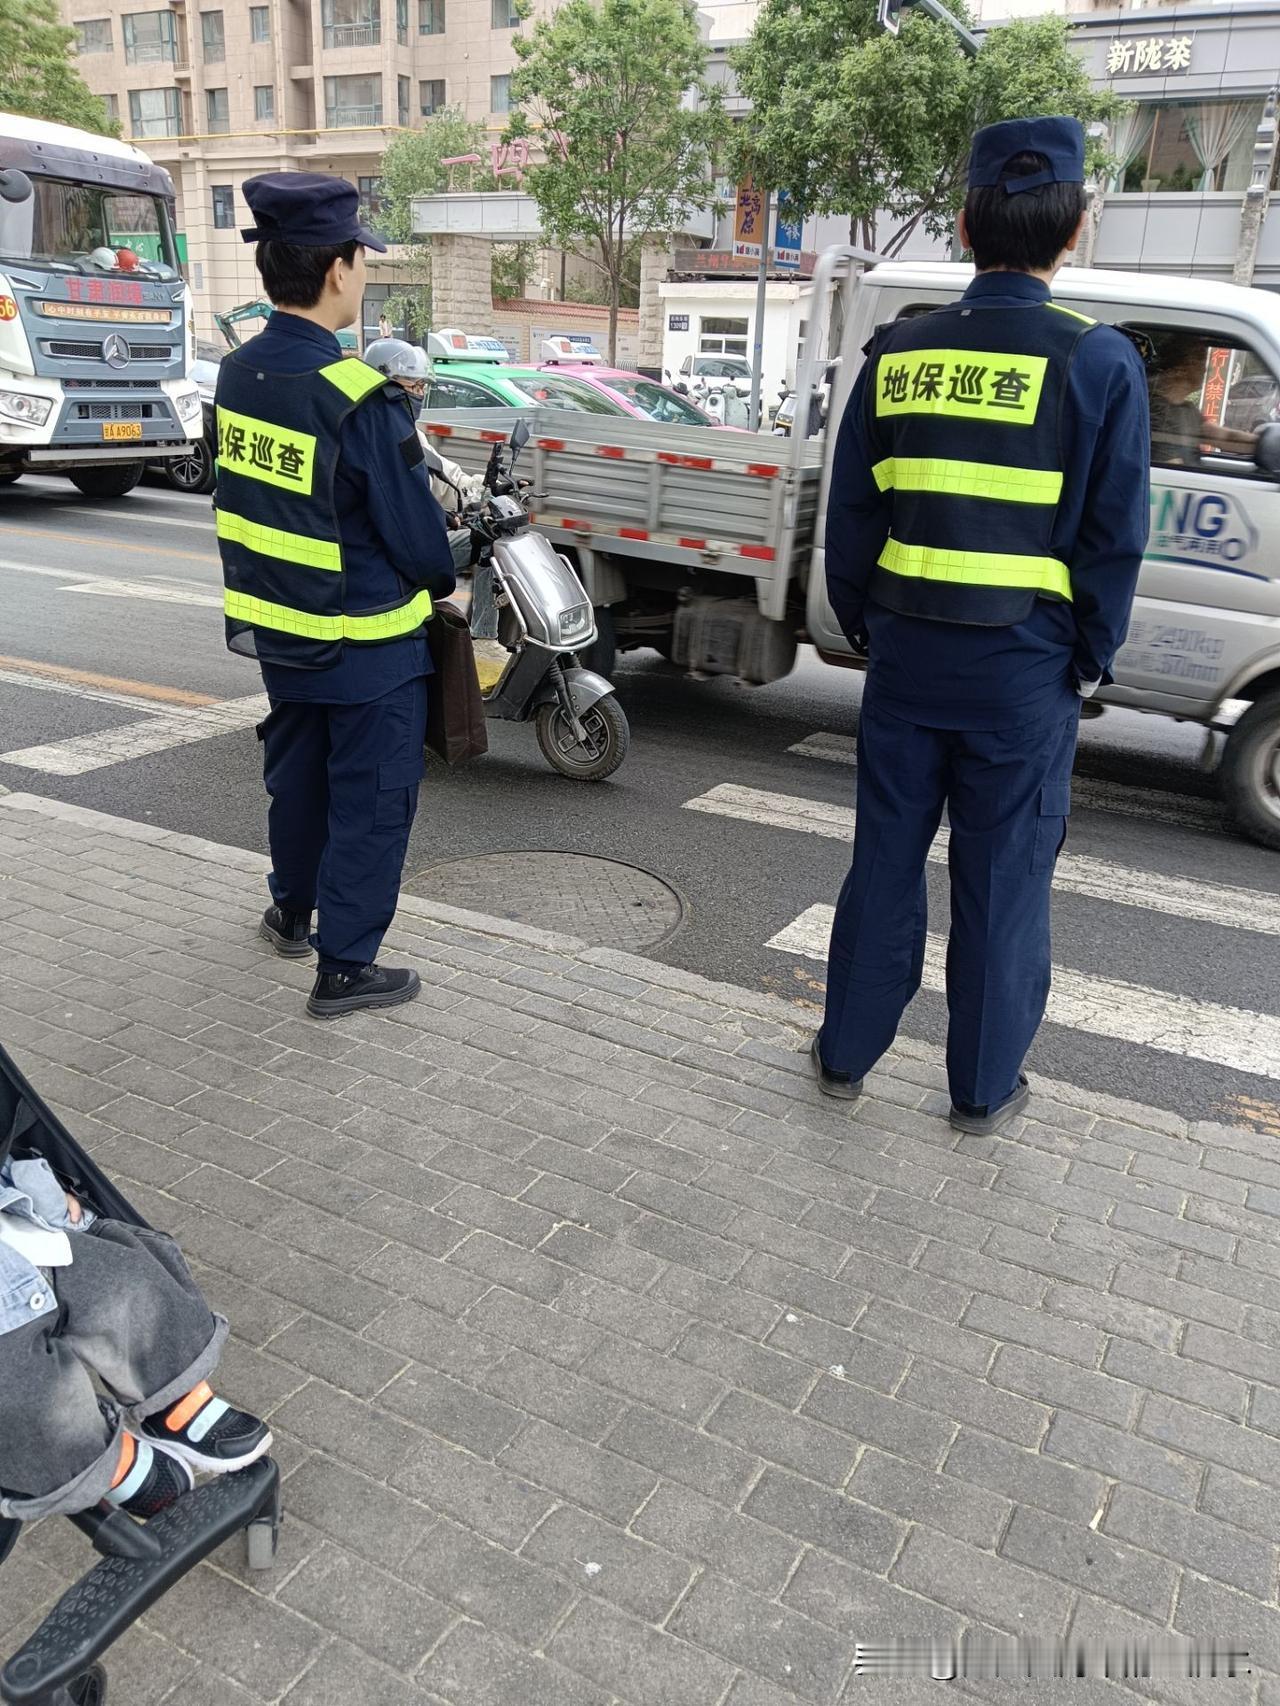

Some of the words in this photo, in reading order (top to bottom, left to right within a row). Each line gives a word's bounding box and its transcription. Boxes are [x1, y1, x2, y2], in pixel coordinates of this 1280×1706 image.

[1105, 36, 1192, 74] 新陇菜
[882, 361, 1031, 410] 地保巡查
[1150, 490, 1228, 538] NG
